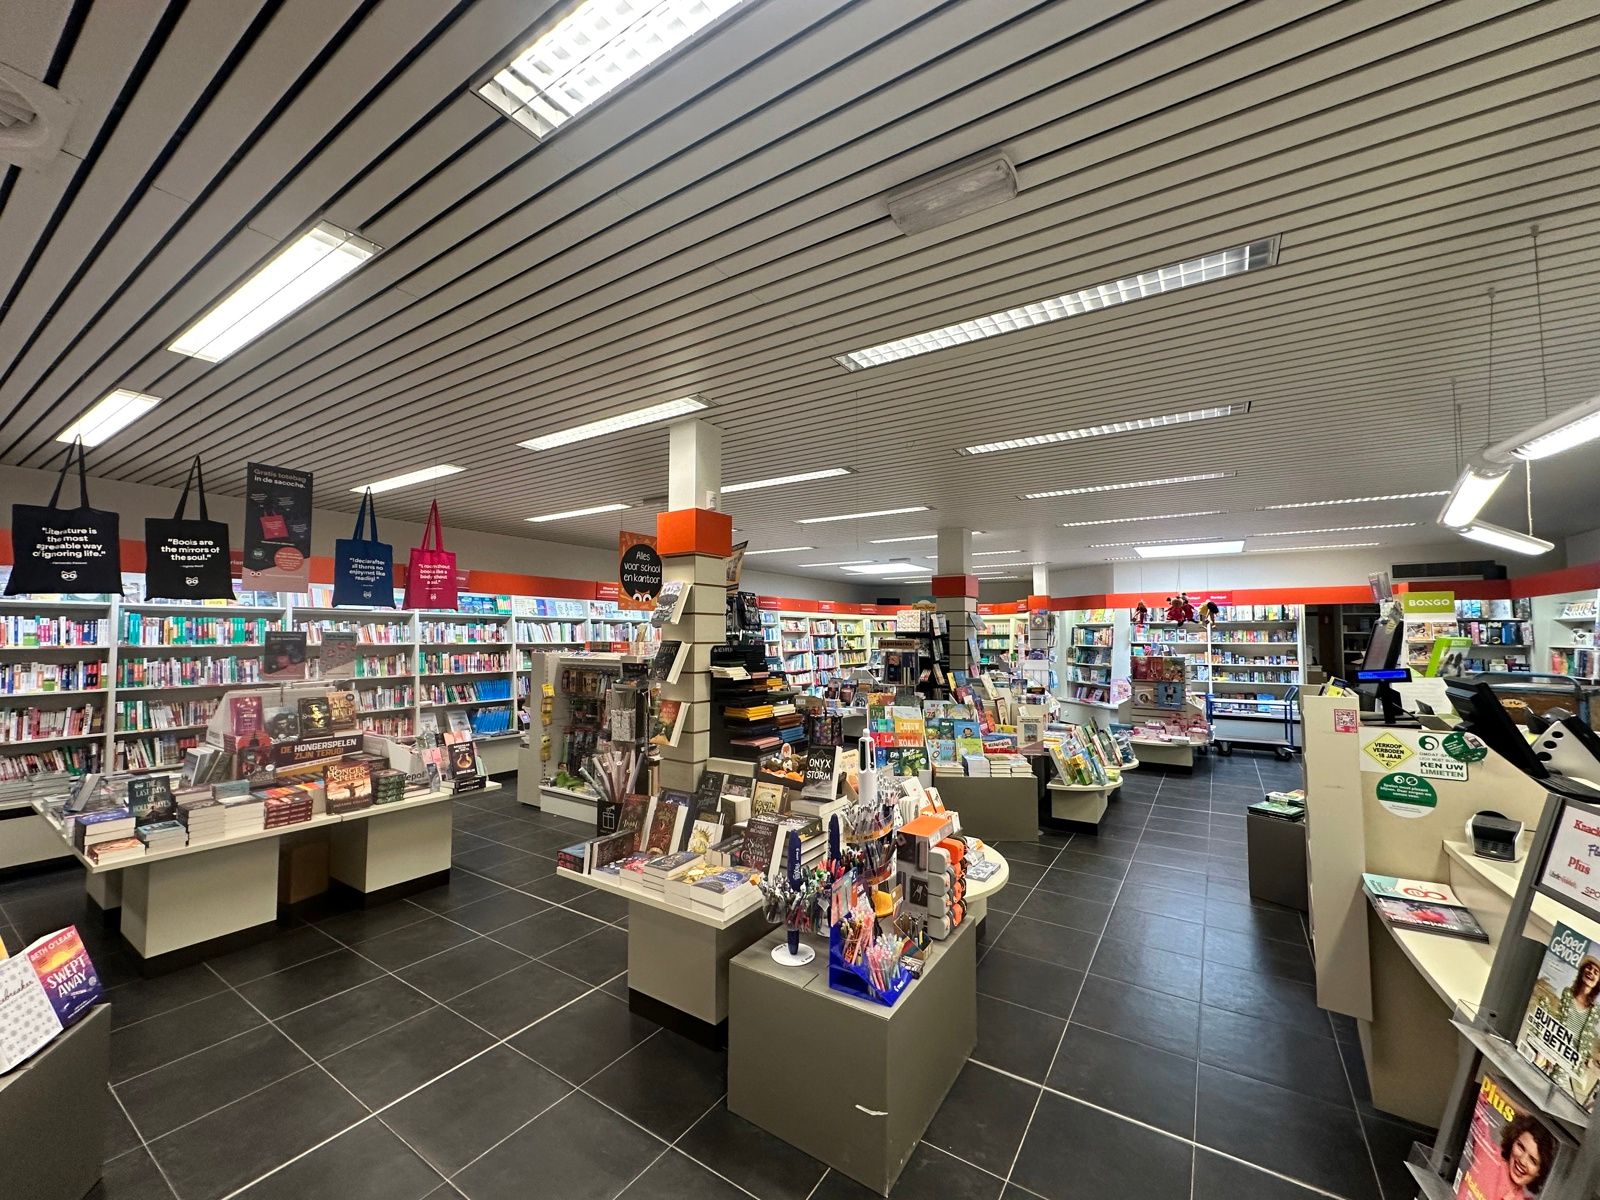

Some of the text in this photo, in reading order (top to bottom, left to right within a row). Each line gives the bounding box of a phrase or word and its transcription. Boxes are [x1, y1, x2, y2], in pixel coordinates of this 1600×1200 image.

[254, 469, 277, 478] Gratis
[42, 550, 82, 559] ignoring
[636, 551, 650, 560] Alles
[624, 562, 660, 572] voor school
[634, 574, 660, 584] kantoor
[294, 739, 357, 752] HONGERSPELEN
[294, 751, 314, 760] ZIJN
[809, 759, 831, 768] ONYX
[807, 770, 830, 780] STORM
[1421, 769, 1464, 778] LIMIETEN
[1568, 856, 1591, 875] Plus
[30, 930, 76, 961] BETH O'LEARY
[1562, 930, 1587, 953] Goed
[1550, 936, 1585, 967] Gevoel
[46, 954, 86, 989] SWEPT
[58, 969, 87, 998] AWAY
[1533, 1019, 1544, 1031] HET
[1535, 1007, 1573, 1043] BUITEN
[1543, 1029, 1580, 1065] BETER
[1480, 1075, 1515, 1122] Plus
